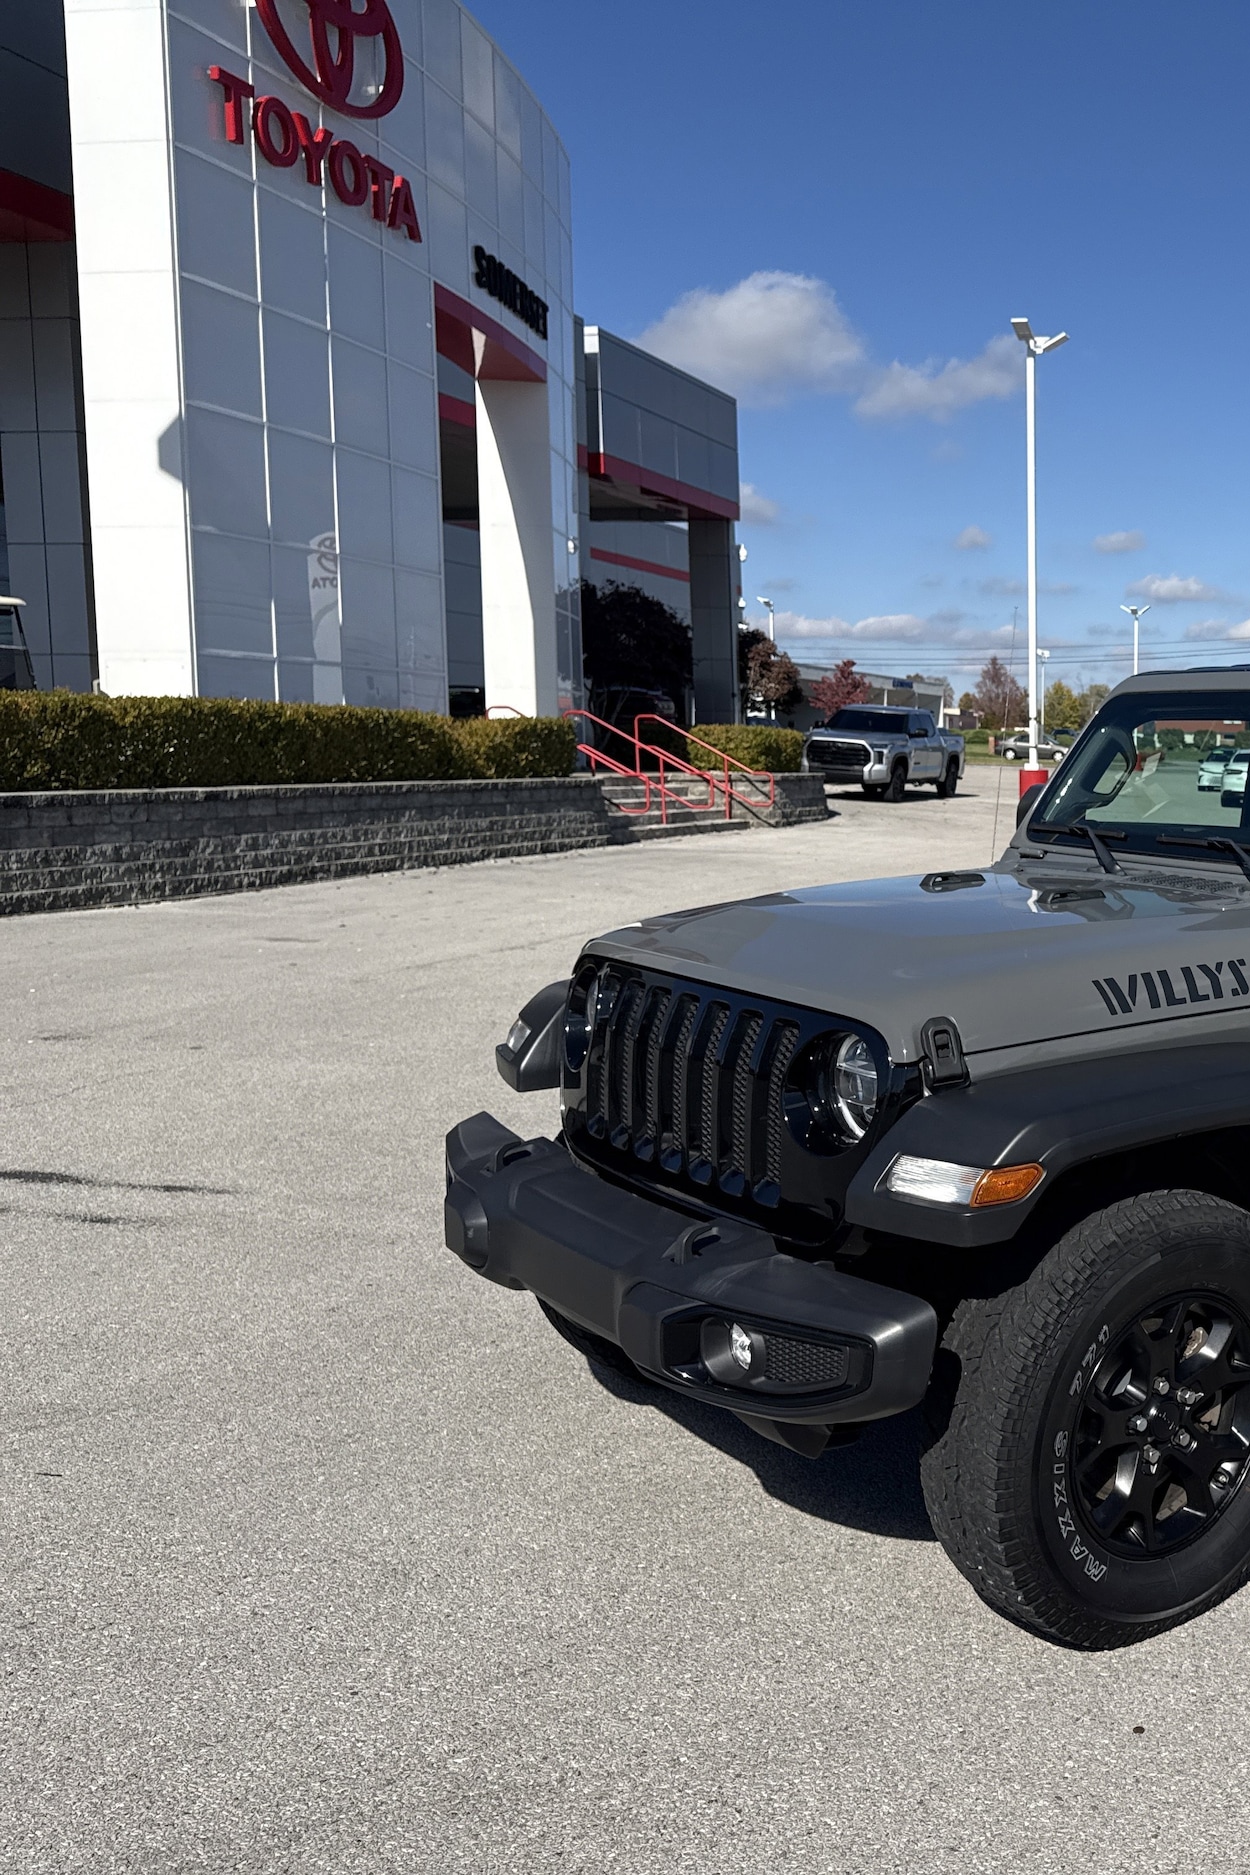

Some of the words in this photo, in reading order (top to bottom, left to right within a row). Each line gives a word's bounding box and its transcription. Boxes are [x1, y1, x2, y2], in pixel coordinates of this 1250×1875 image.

[209, 65, 423, 243] TOYOTA
[1092, 958, 1250, 1016] WILLYS
[1053, 1430, 1107, 1581] MAXXIS
